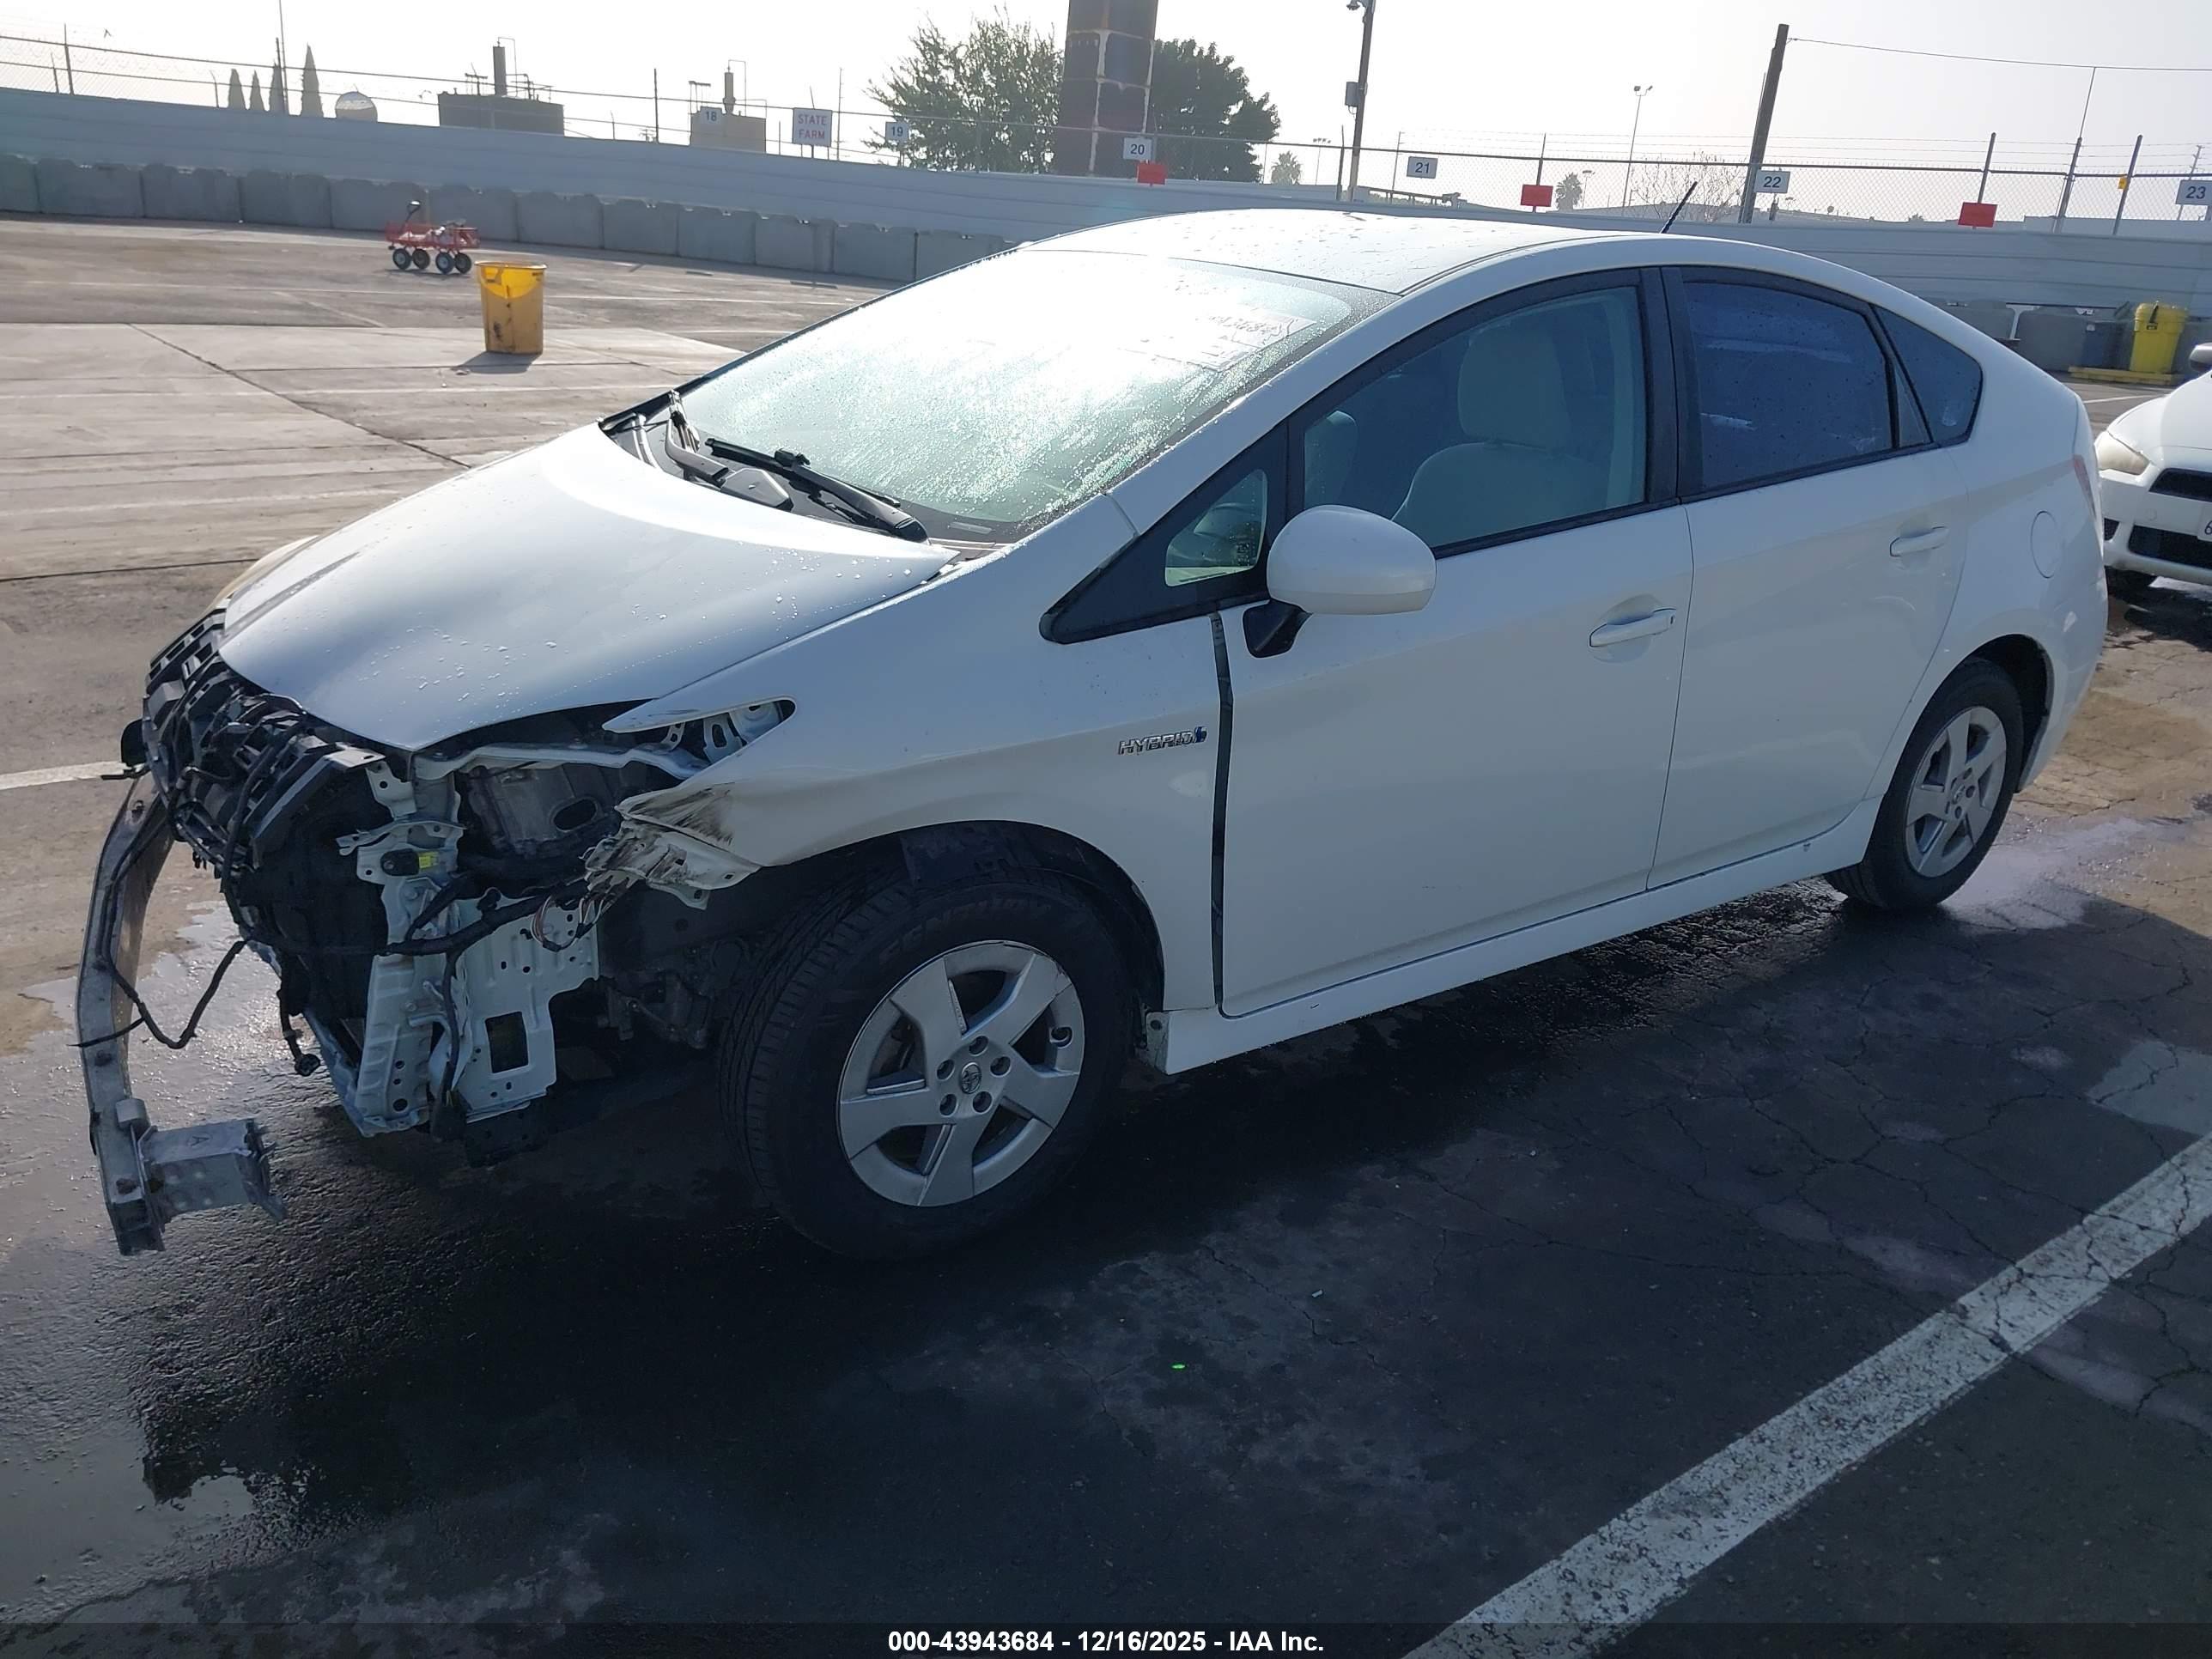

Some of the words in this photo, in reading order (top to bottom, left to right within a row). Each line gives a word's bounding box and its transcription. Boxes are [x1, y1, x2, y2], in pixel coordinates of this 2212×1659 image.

[705, 111, 717, 122] 18
[797, 113, 827, 125] STATE
[799, 129, 825, 139] FARM
[891, 126, 903, 137] 19
[1130, 143, 1146, 155] 20
[1414, 161, 1431, 174] 21
[1763, 175, 1782, 188] 22
[2185, 185, 2207, 199] 23
[1118, 730, 1194, 755] HYBRID
